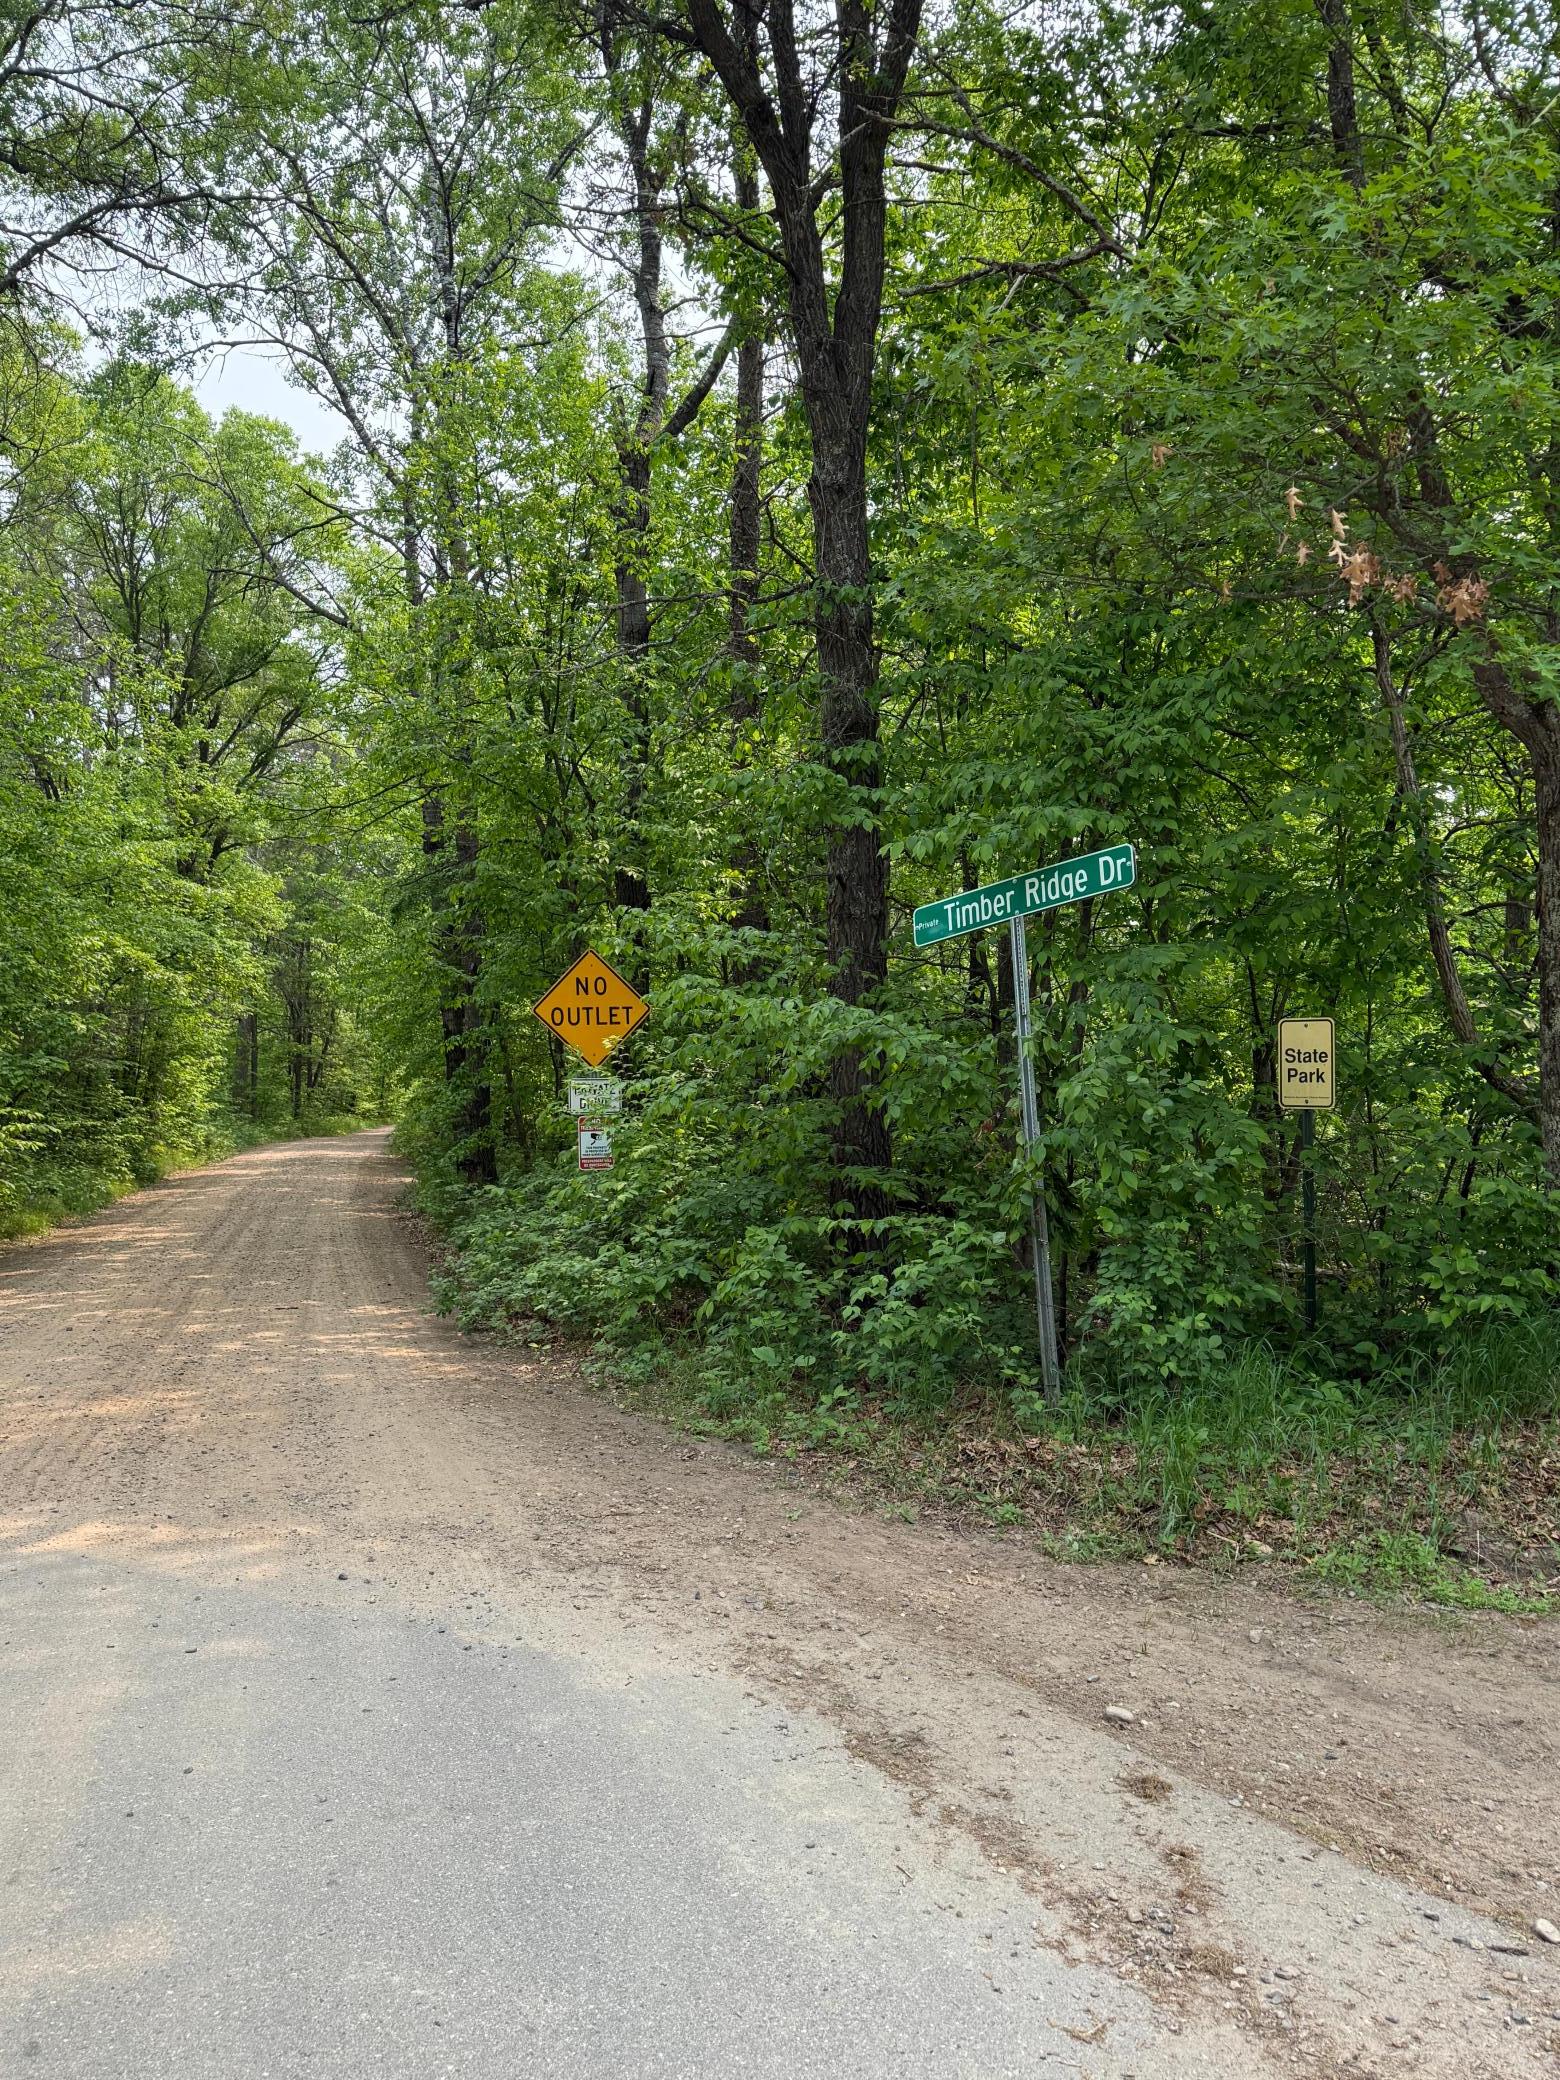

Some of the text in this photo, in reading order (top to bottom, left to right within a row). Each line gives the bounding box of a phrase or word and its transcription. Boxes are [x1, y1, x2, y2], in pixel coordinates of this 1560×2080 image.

[918, 855, 1127, 931] Private Timber Ridge Dr
[575, 976, 607, 996] NO
[550, 1006, 633, 1026] OUTLET
[1284, 1048, 1329, 1063] State
[1287, 1068, 1326, 1083] Park
